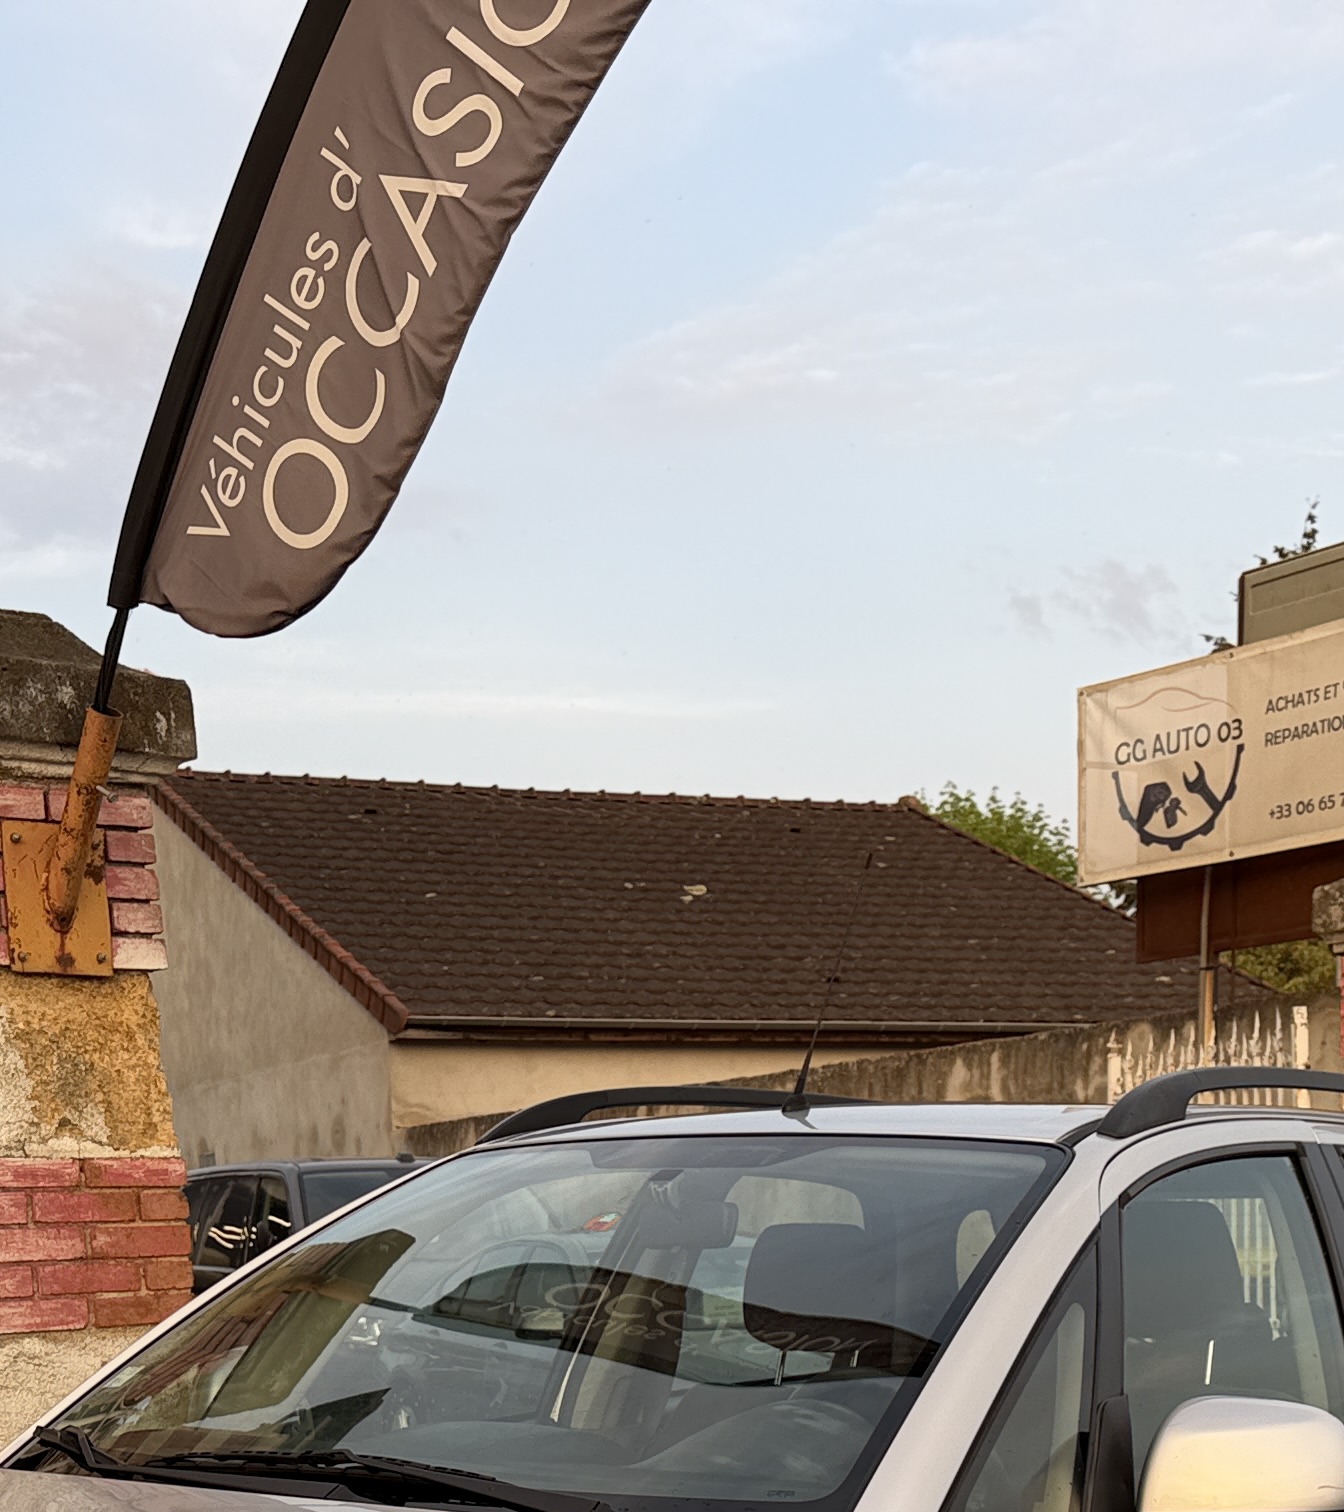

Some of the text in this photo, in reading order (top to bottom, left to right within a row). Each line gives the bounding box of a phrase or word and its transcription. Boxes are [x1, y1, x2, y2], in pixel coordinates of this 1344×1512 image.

[186, 231, 340, 539] Véhicules
[1265, 691, 1319, 715] ACHATS
[1323, 684, 1341, 704] ET
[1115, 718, 1244, 766] GG AUTO 03
[1268, 803, 1292, 821] +33
[1296, 799, 1314, 817] 06
[1318, 796, 1336, 813] 65
